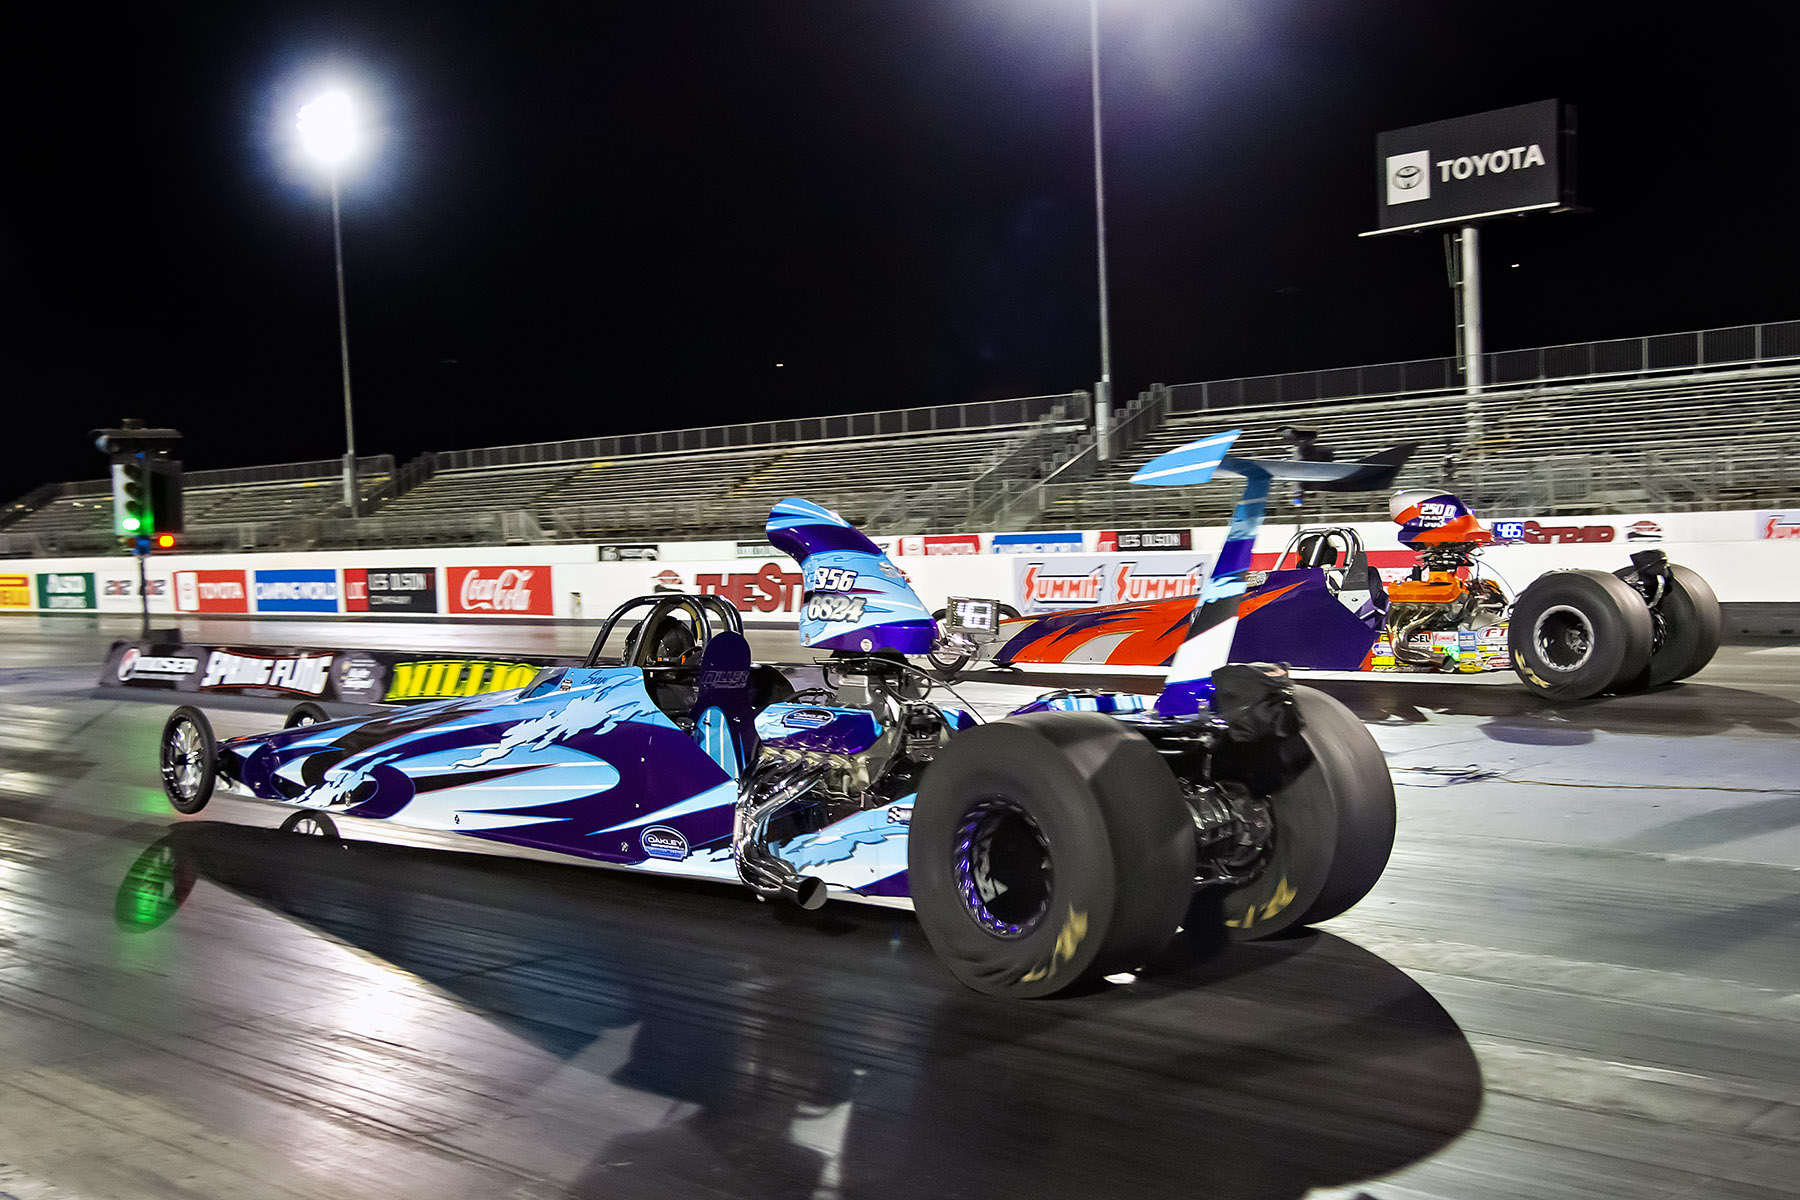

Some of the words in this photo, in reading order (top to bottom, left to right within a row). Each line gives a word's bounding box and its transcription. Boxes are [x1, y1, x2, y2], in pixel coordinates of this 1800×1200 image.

[1436, 144, 1546, 183] TOYOTA
[1420, 503, 1445, 515] 250
[199, 582, 246, 600] TOYOTA
[808, 594, 867, 622] 6824
[647, 836, 684, 848] OAKLEY
